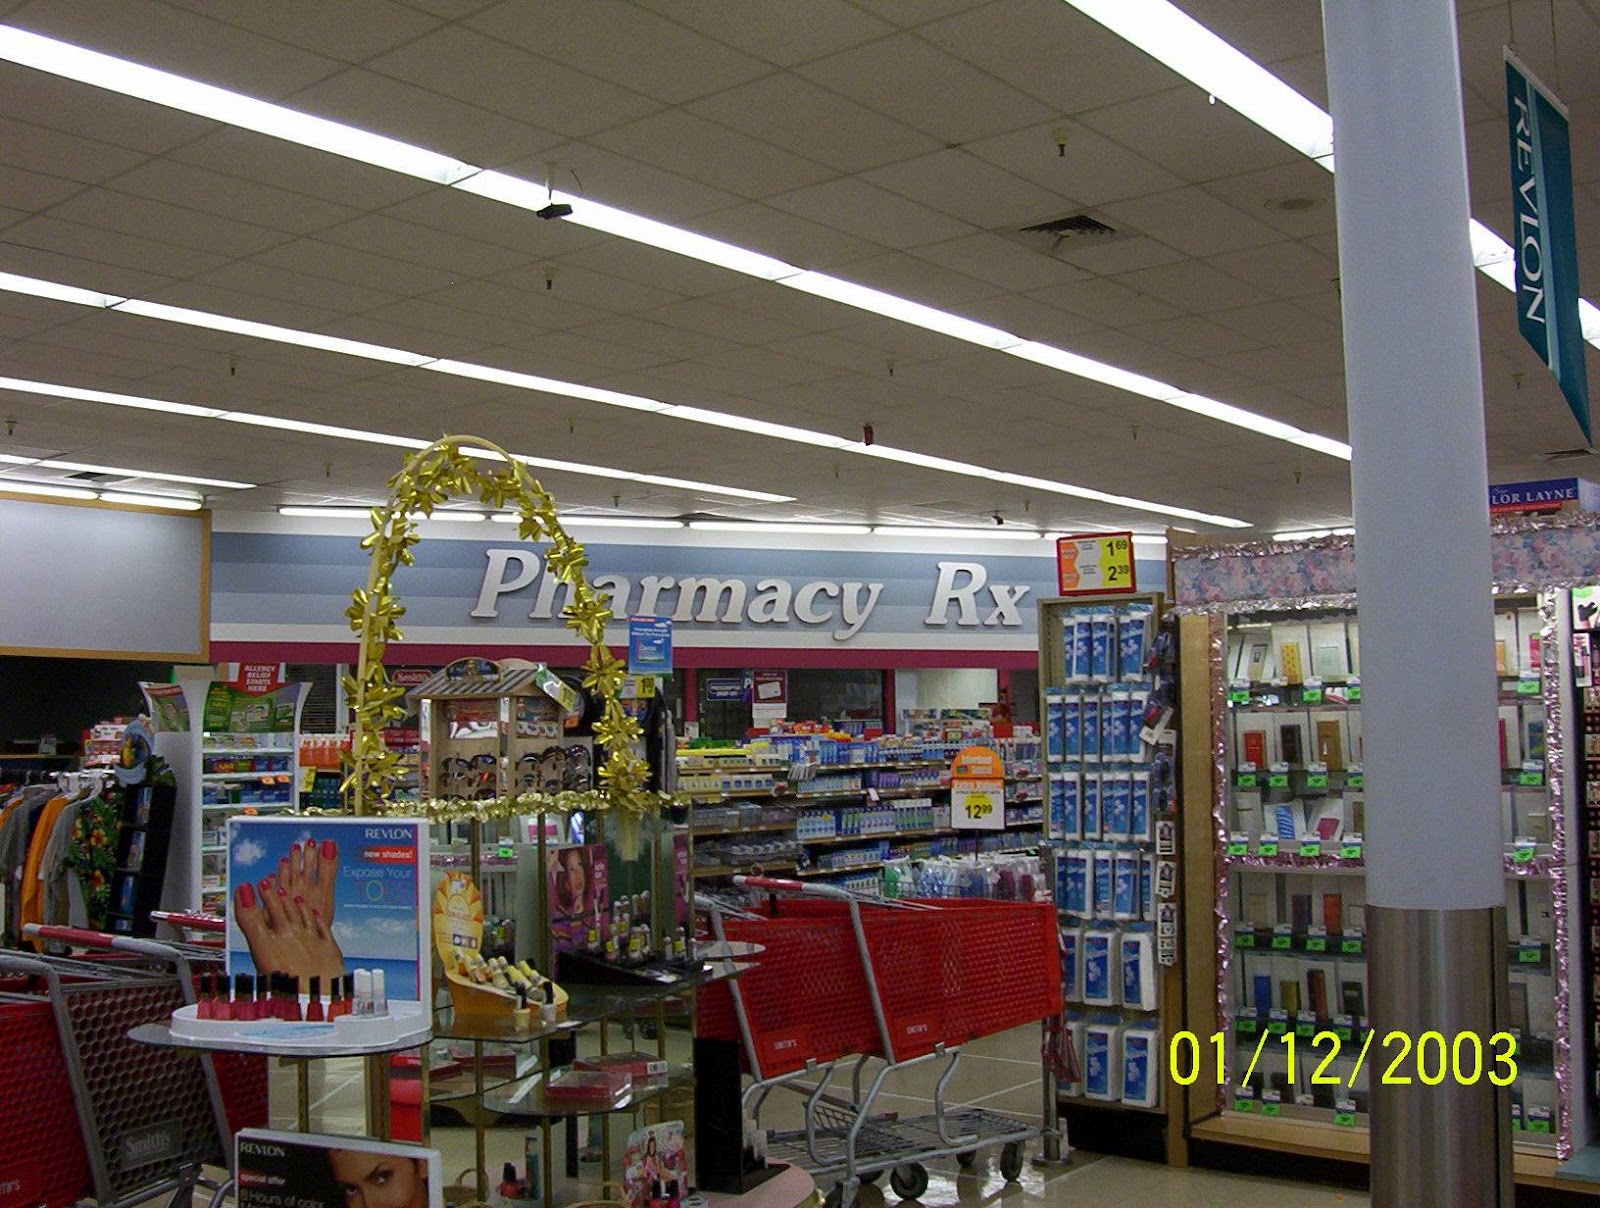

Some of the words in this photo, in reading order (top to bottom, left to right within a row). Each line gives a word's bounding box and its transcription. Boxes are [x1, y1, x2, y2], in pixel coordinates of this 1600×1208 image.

[1514, 96, 1545, 323] REVLON
[1526, 488, 1574, 502] LAYNE
[470, 549, 884, 642] Pharmacy
[925, 561, 1030, 626] Rx
[365, 828, 412, 840] REVLON
[343, 865, 385, 880] Expose
[385, 867, 412, 879] Your
[240, 1142, 286, 1157] REVLON
